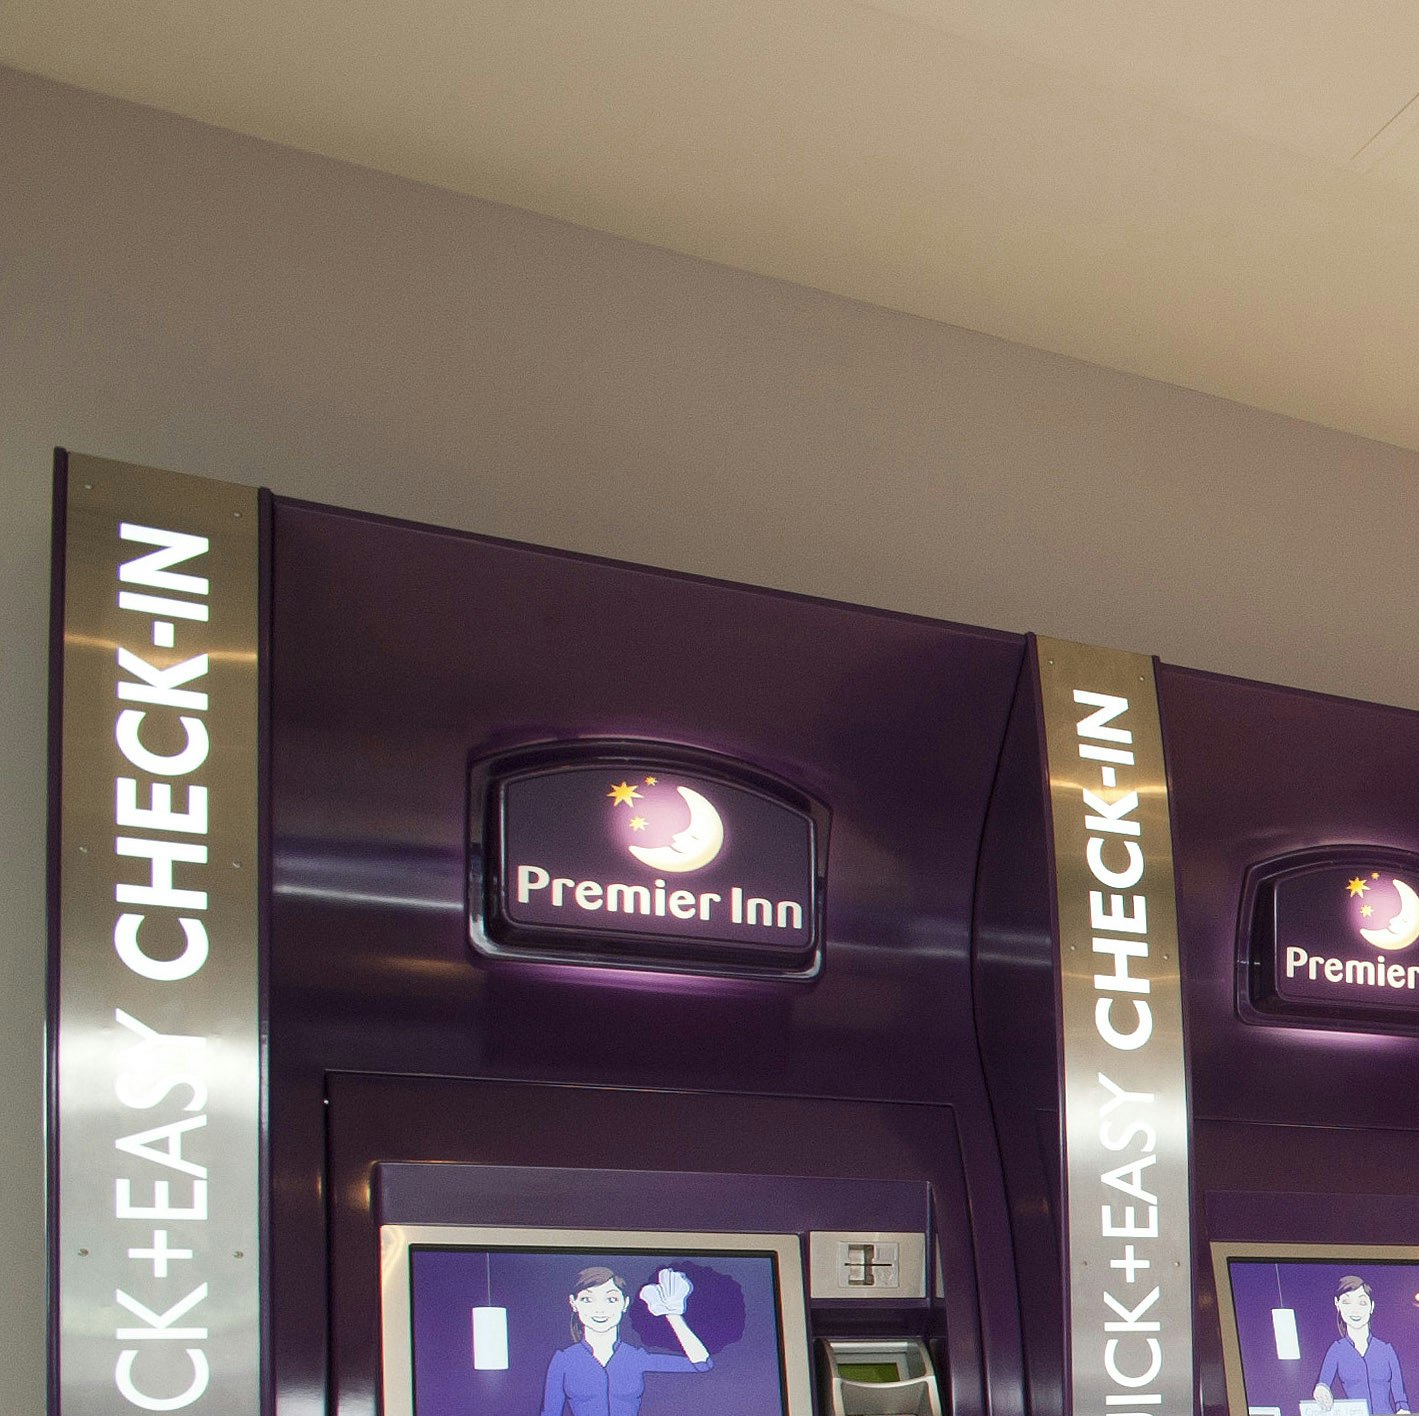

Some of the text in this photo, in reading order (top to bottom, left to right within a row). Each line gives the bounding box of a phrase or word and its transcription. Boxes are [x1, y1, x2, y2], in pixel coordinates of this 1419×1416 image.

[115, 524, 209, 981] CHECK-IN
[517, 865, 803, 929] Premier Inn
[1073, 689, 1153, 1051] CHECK-IN
